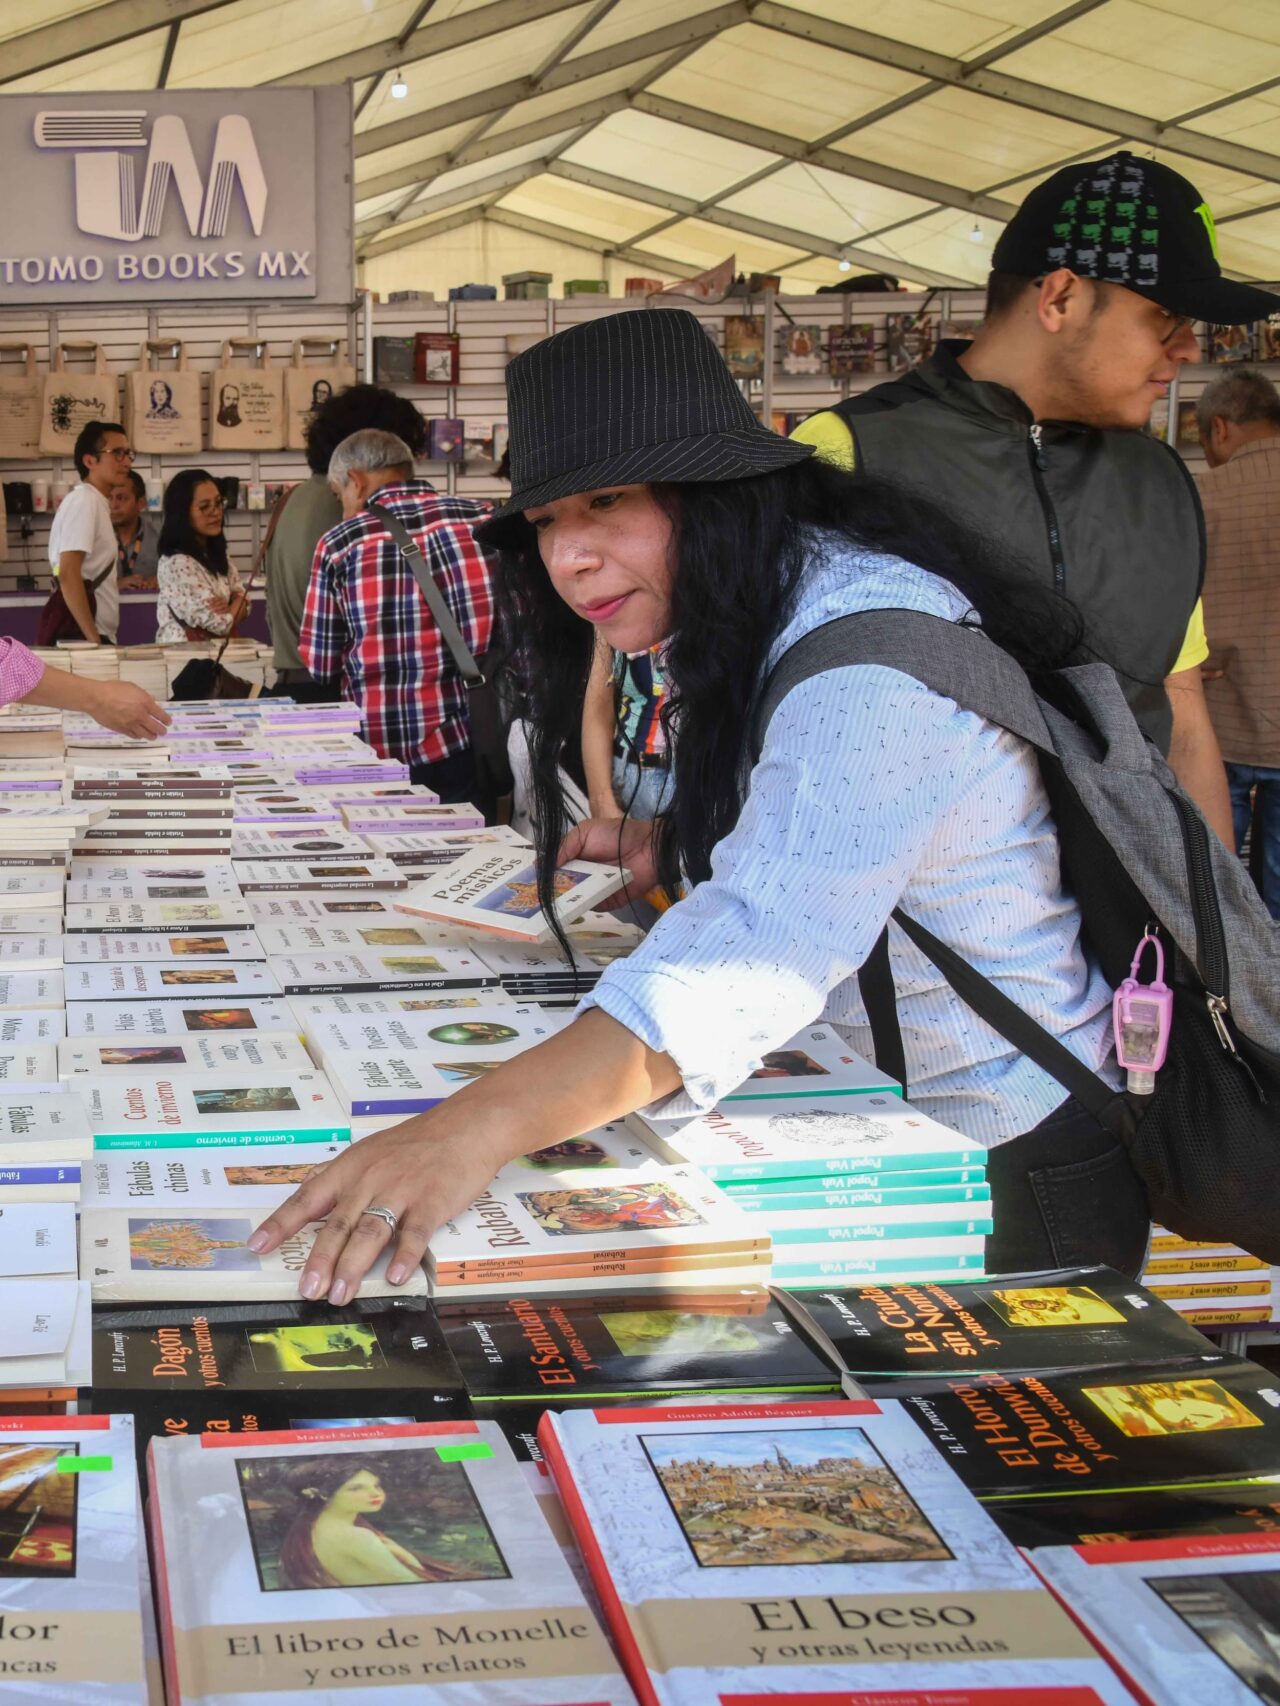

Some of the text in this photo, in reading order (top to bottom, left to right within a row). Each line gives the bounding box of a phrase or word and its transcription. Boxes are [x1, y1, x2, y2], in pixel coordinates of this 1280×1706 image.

[0, 250, 311, 284] TOMO BOOKS MX
[431, 856, 504, 900] Poemas
[124, 1087, 148, 1121] Cuentos
[154, 1081, 182, 1125] de invierno
[7, 1104, 34, 1134] Fábulas
[196, 1133, 295, 1145] Cuentos de invierno
[716, 1131, 773, 1158] Popol
[129, 1160, 155, 1197] Fábulas
[163, 1162, 190, 1193] chinas
[826, 1158, 882, 1171] Popol Vuh
[822, 1176, 879, 1189] Popol Vuh
[825, 1193, 883, 1206] Popol Vuh
[828, 1226, 885, 1239] Popol Vuh
[592, 1262, 626, 1272] Rubaiyat
[820, 1261, 877, 1274] Popol Vuh
[904, 1331, 939, 1355] La
[955, 1311, 1002, 1346] y otros
[150, 1328, 193, 1377] Dagón
[190, 1315, 226, 1387] y otros cuentos
[568, 1339, 592, 1362] otros
[942, 1331, 978, 1356] sin
[537, 1368, 578, 1386] El
[666, 1406, 814, 1421] Gustavo Adolfo Bécquer
[945, 1382, 1041, 1467] El Horror
[973, 1373, 1093, 1475] de Dunwich
[1019, 1375, 1120, 1463] y otros cuentos
[296, 1429, 386, 1442] Marcel Schwob
[939, 1432, 958, 1442] P.
[947, 1442, 969, 1455] H.
[742, 1596, 978, 1634] El beso
[225, 1618, 591, 1657] El libro de Monelle
[750, 1634, 1009, 1663] y otras leyendas
[303, 1654, 527, 1684] y otros relatos
